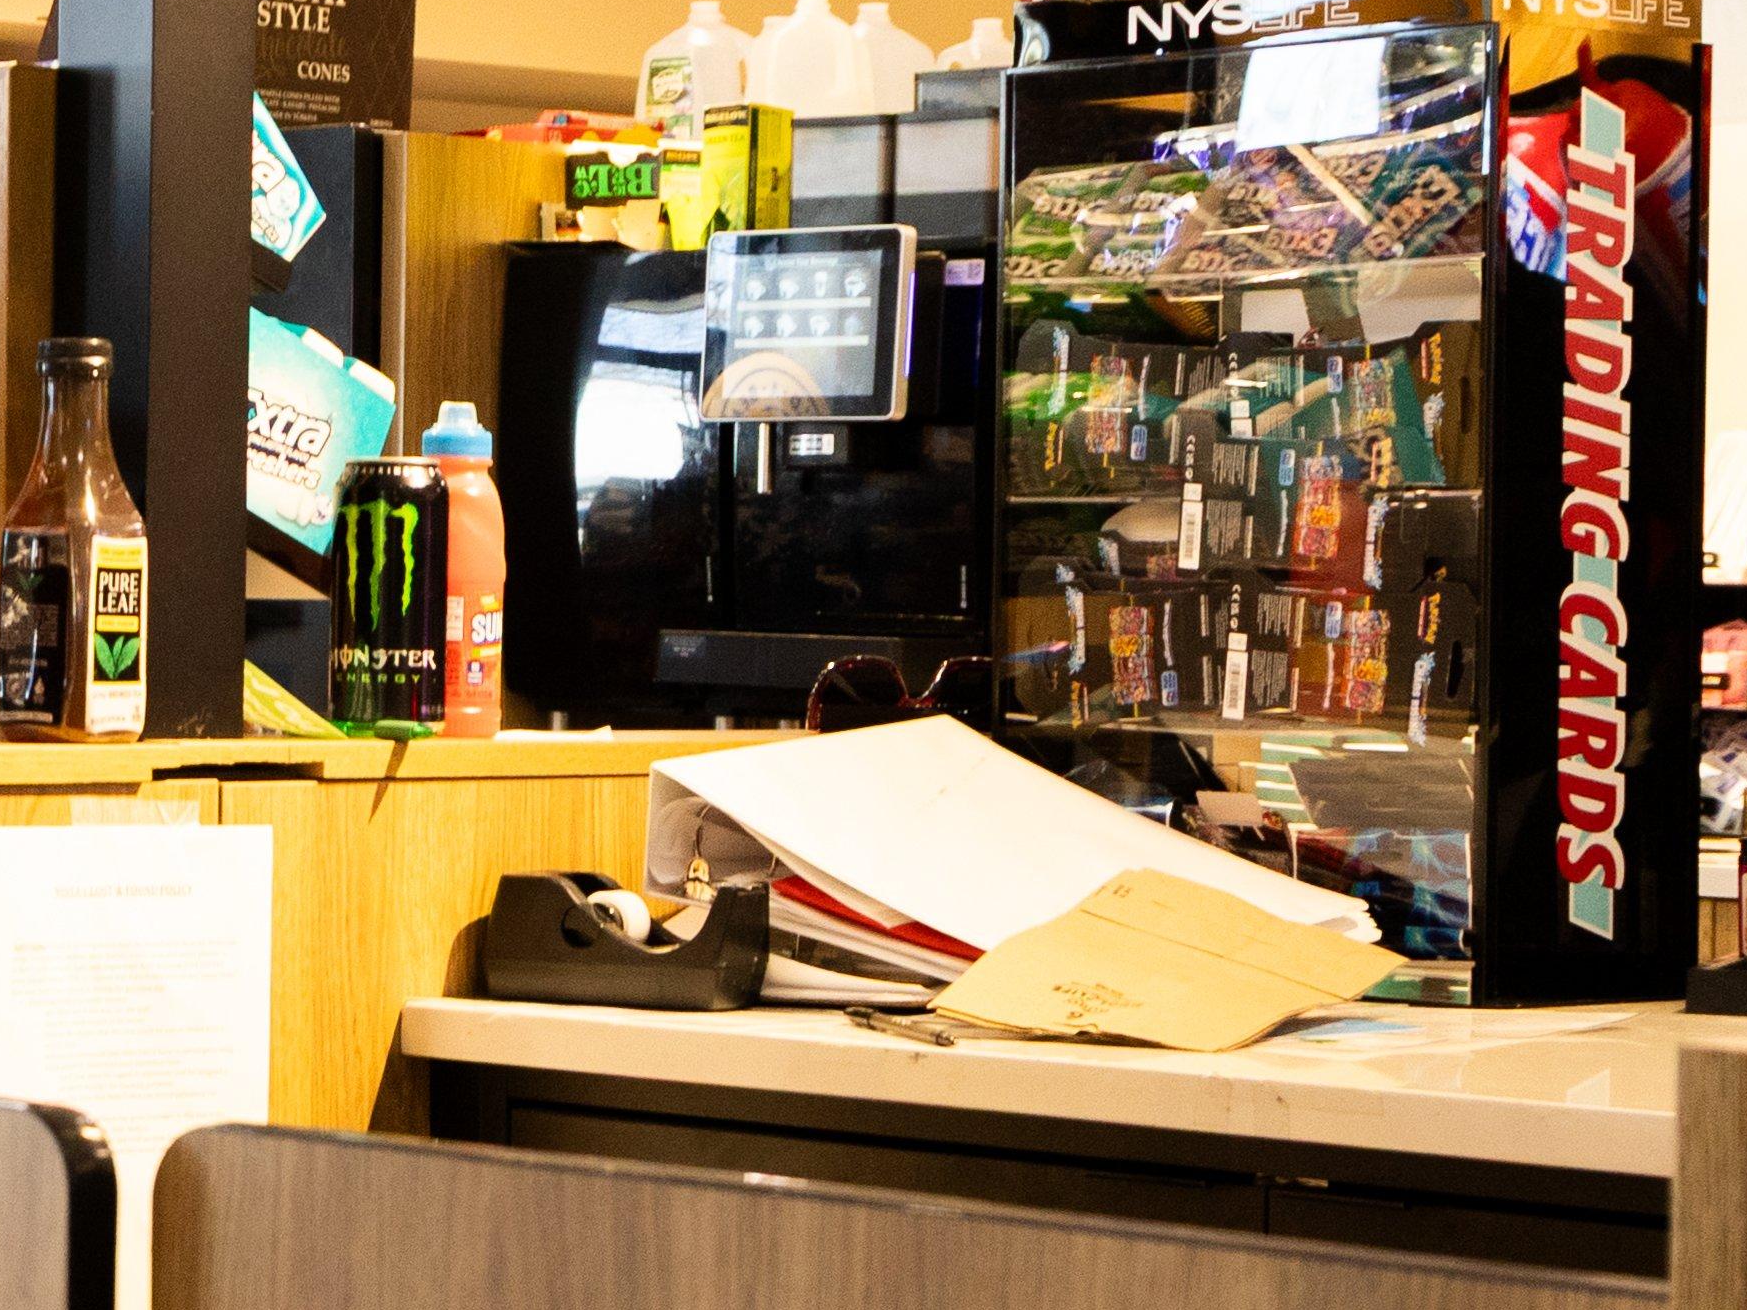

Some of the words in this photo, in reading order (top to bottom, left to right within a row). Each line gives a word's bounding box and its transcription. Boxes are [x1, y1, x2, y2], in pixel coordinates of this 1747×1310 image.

[257, 0, 331, 34] STYLE
[297, 60, 351, 83] CONES
[1560, 144, 1636, 562] TRADING
[98, 571, 140, 592] PURE
[98, 593, 139, 614] LEAF
[336, 673, 421, 685] ENERGY
[1555, 579, 1627, 890] CARDS
